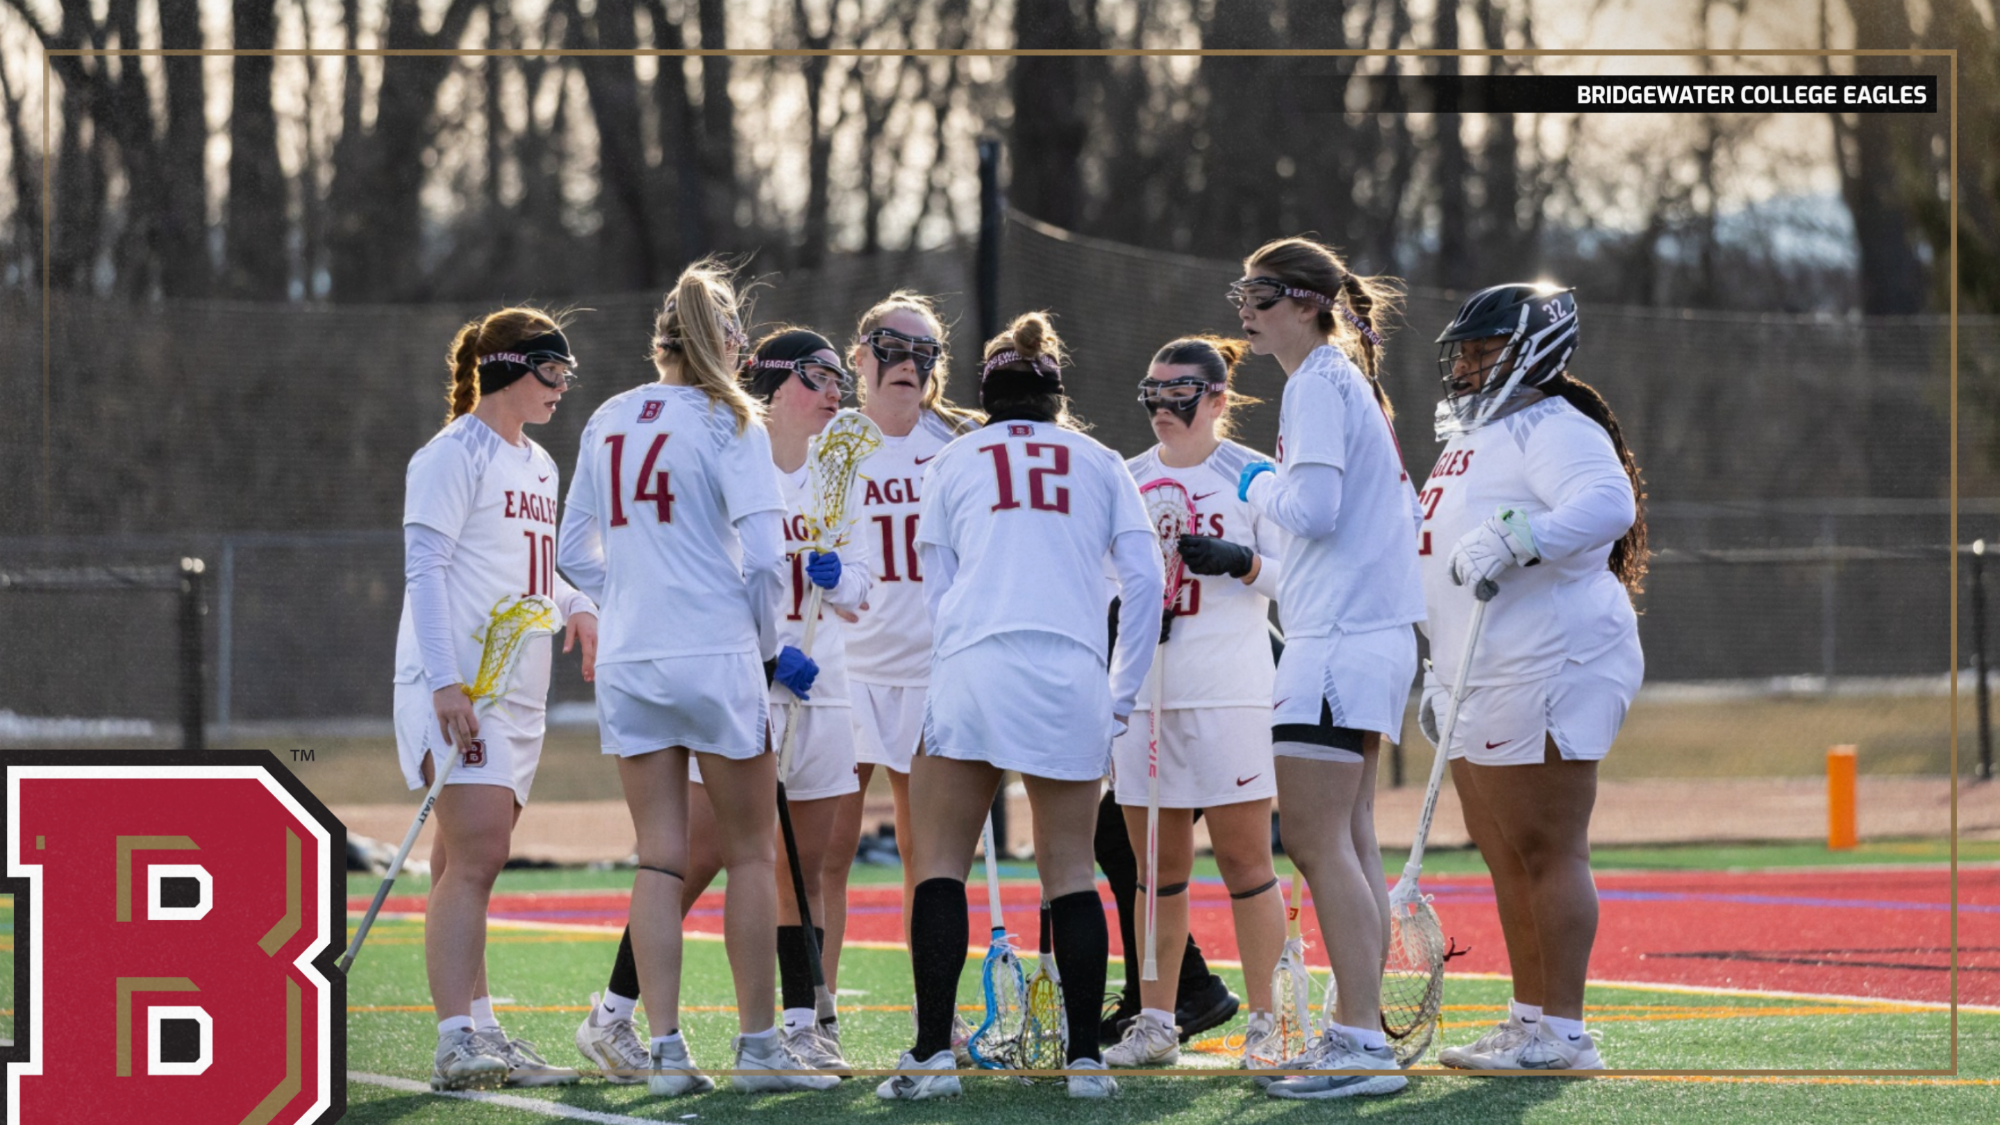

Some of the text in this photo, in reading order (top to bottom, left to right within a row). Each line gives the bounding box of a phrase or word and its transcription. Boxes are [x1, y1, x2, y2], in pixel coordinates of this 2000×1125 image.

[1542, 299, 1567, 323] 32
[604, 432, 675, 528] 14
[978, 442, 1071, 516] 12
[1431, 449, 1475, 479] GLES
[863, 478, 921, 506] AGL
[521, 529, 554, 600] 10
